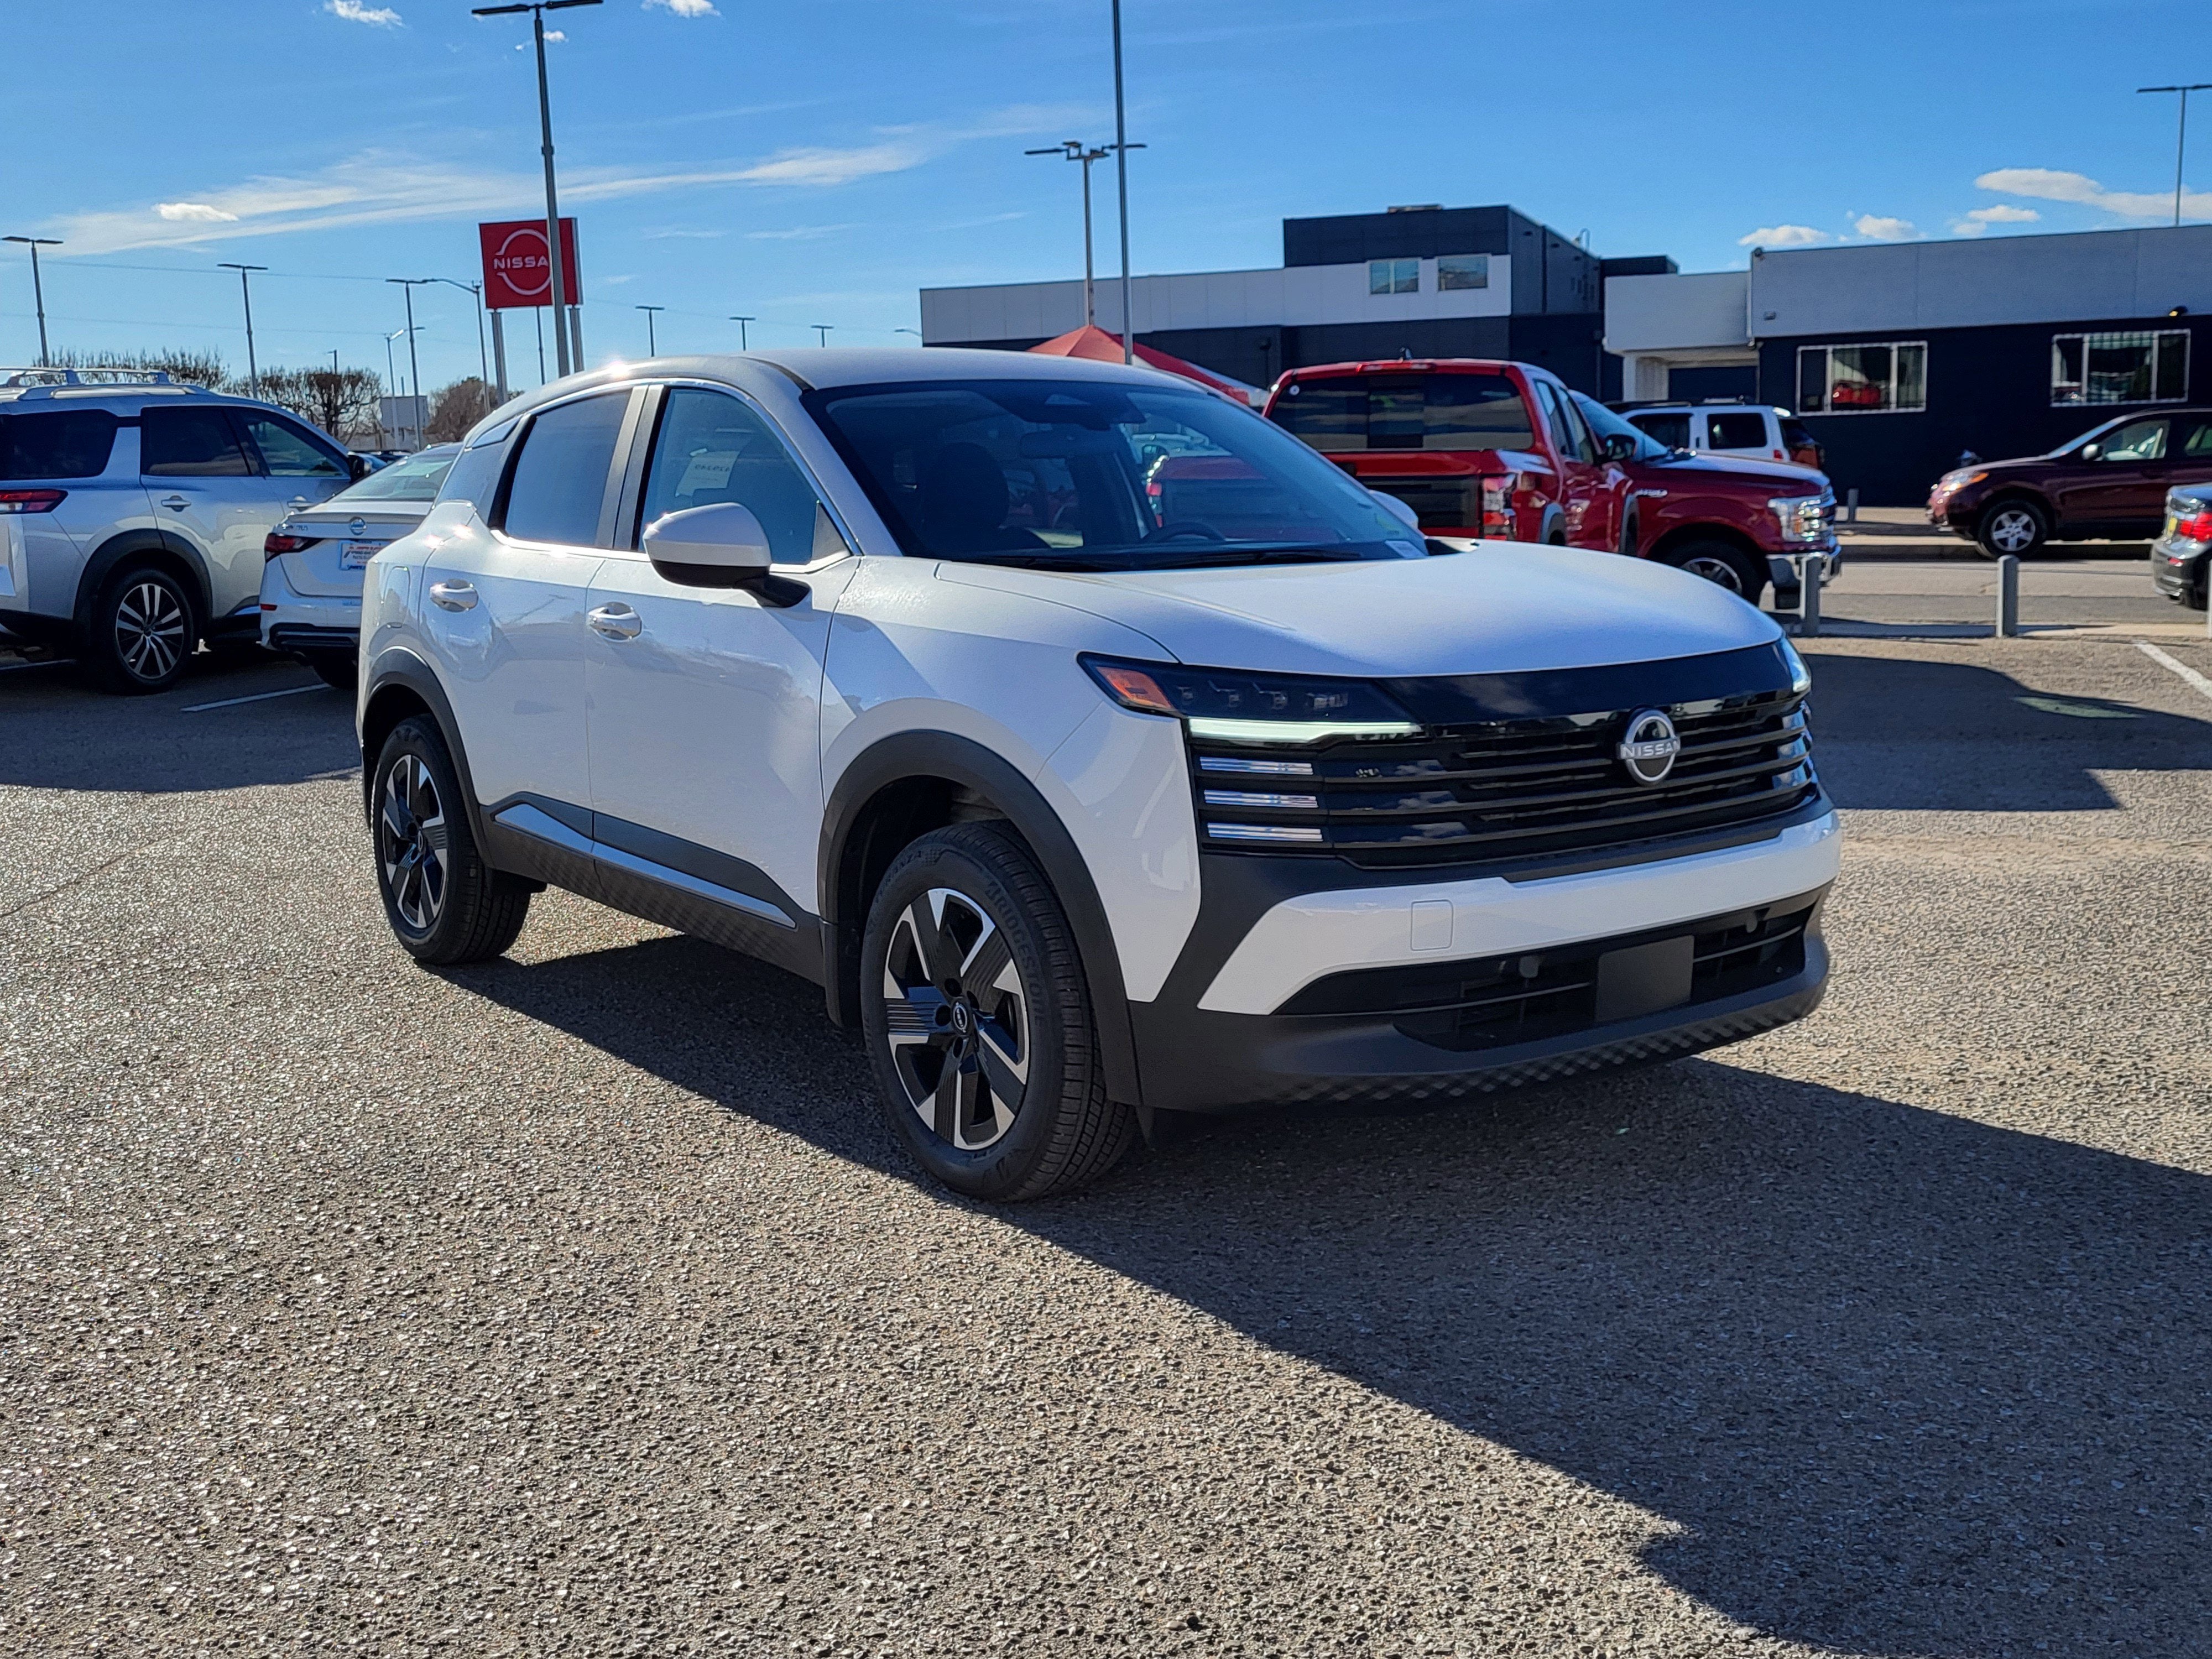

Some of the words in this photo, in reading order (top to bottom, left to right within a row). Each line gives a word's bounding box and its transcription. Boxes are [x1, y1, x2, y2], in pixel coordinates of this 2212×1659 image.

[494, 255, 549, 269] NISSA
[1621, 740, 1679, 758] NISSAN
[985, 880, 1045, 1026] BRIDGESTONE
